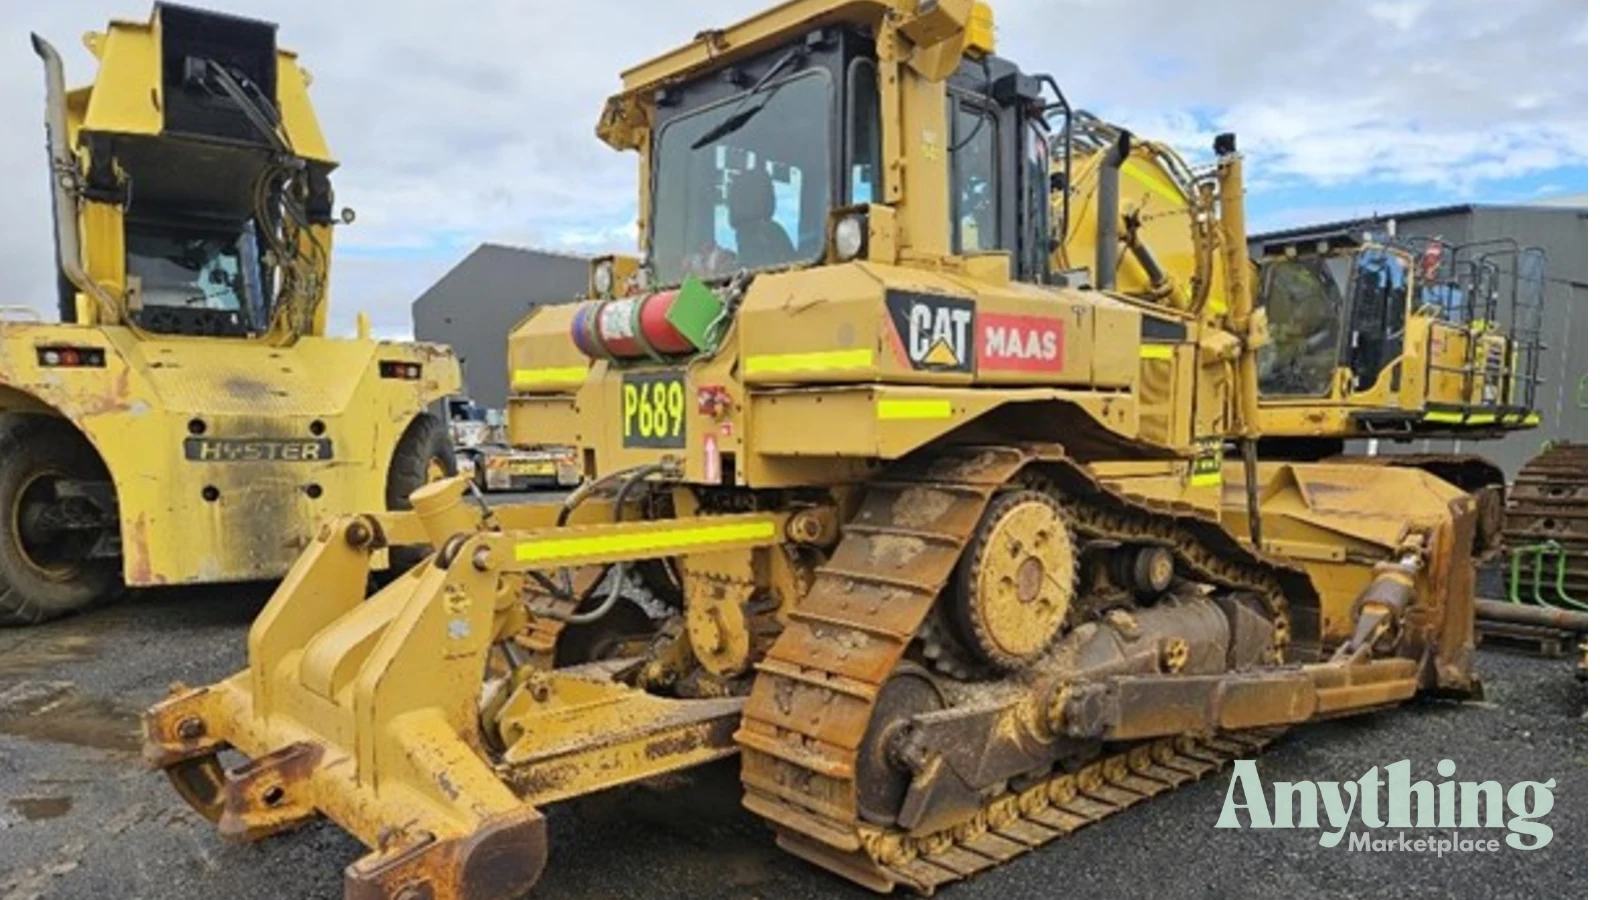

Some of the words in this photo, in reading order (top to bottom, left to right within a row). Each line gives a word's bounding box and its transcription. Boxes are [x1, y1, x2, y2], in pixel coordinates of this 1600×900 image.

[909, 303, 972, 365] CAT
[985, 325, 1058, 360] MAAS
[624, 381, 683, 437] P689
[200, 442, 320, 461] HYSTER
